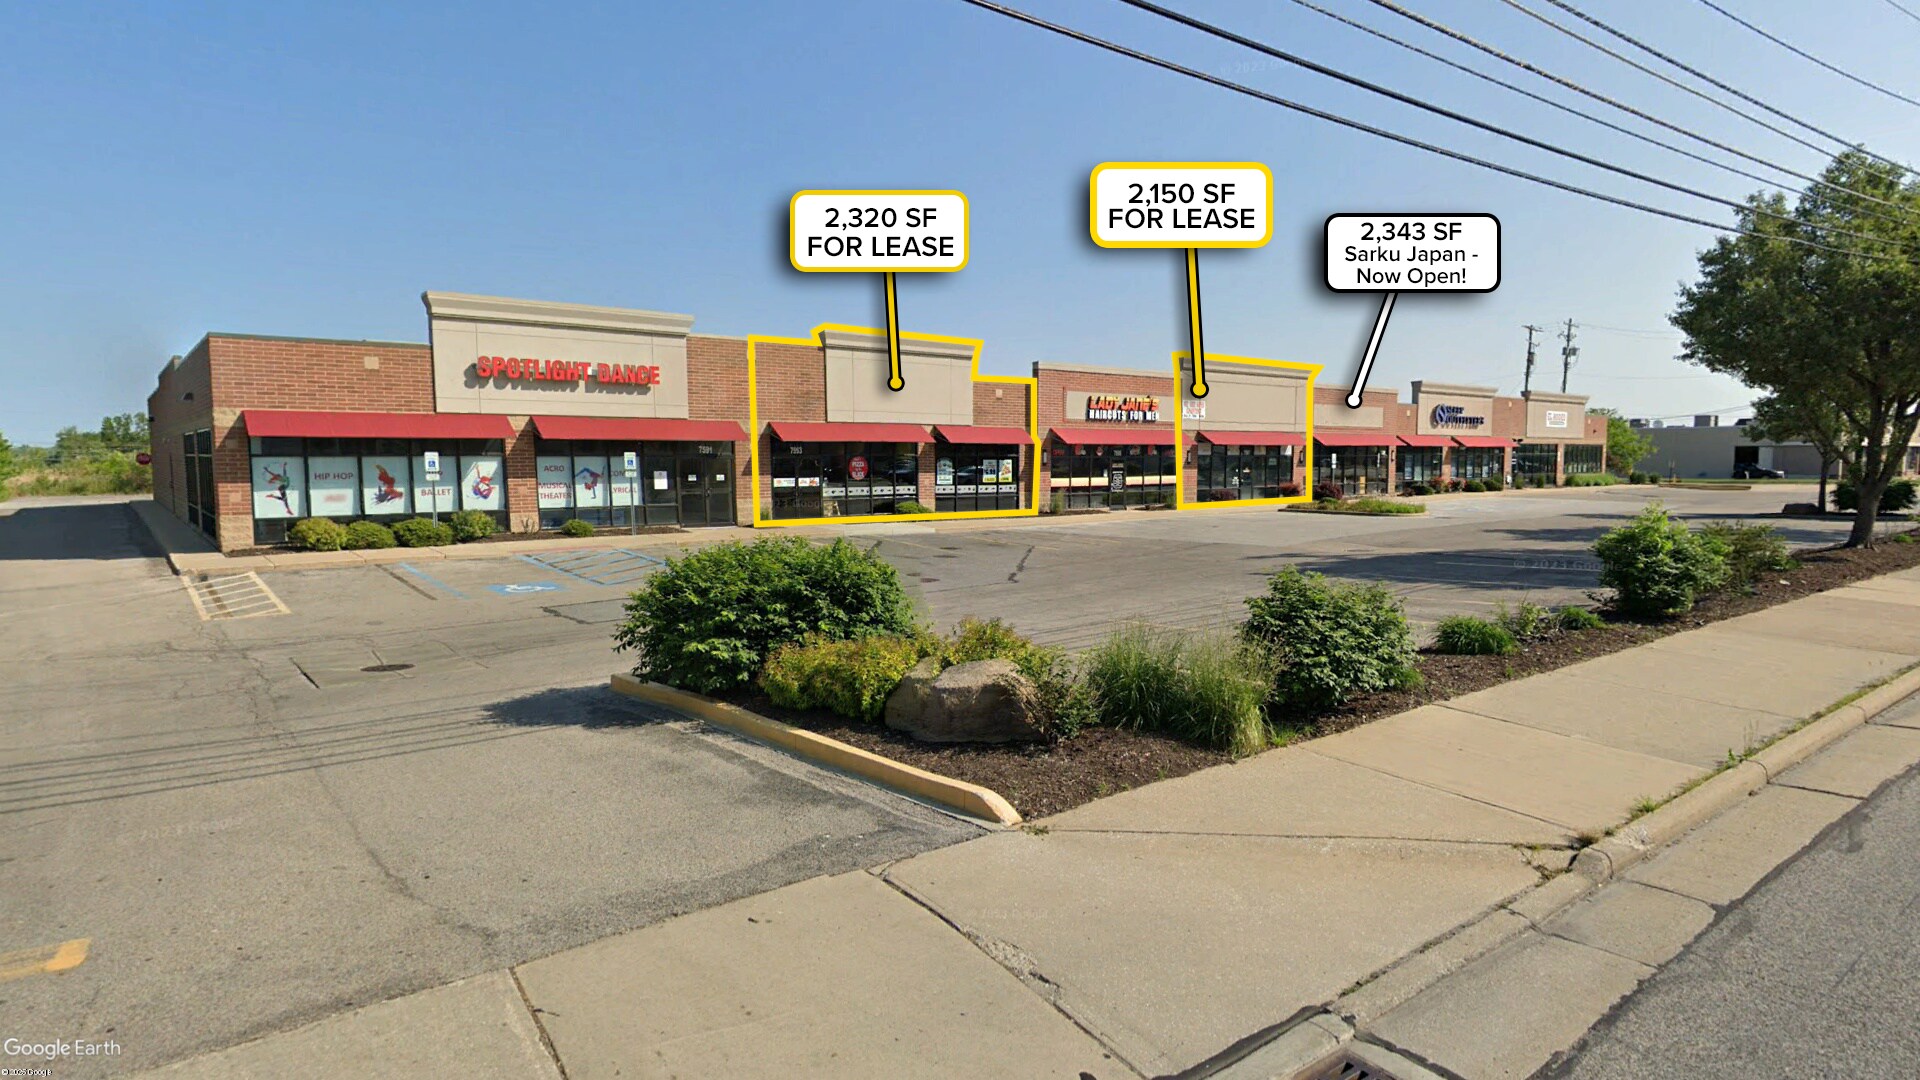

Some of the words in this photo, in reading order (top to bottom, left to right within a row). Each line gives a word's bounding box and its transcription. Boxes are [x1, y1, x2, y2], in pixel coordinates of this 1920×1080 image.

[477, 355, 592, 382] SPOTLIGHT
[597, 362, 661, 385] DANCE
[1089, 395, 1120, 410] LADY
[1088, 409, 1127, 420] HAIRCUTS
[1129, 410, 1144, 421] FOR
[1145, 410, 1160, 421] MEN
[544, 465, 565, 473] ACRO
[314, 472, 331, 481] HIP
[333, 472, 354, 481] HOP
[538, 481, 573, 489] MUSICAL
[421, 488, 452, 497] BALLET
[610, 486, 637, 494] YRICL
[539, 491, 573, 500] THEATER
